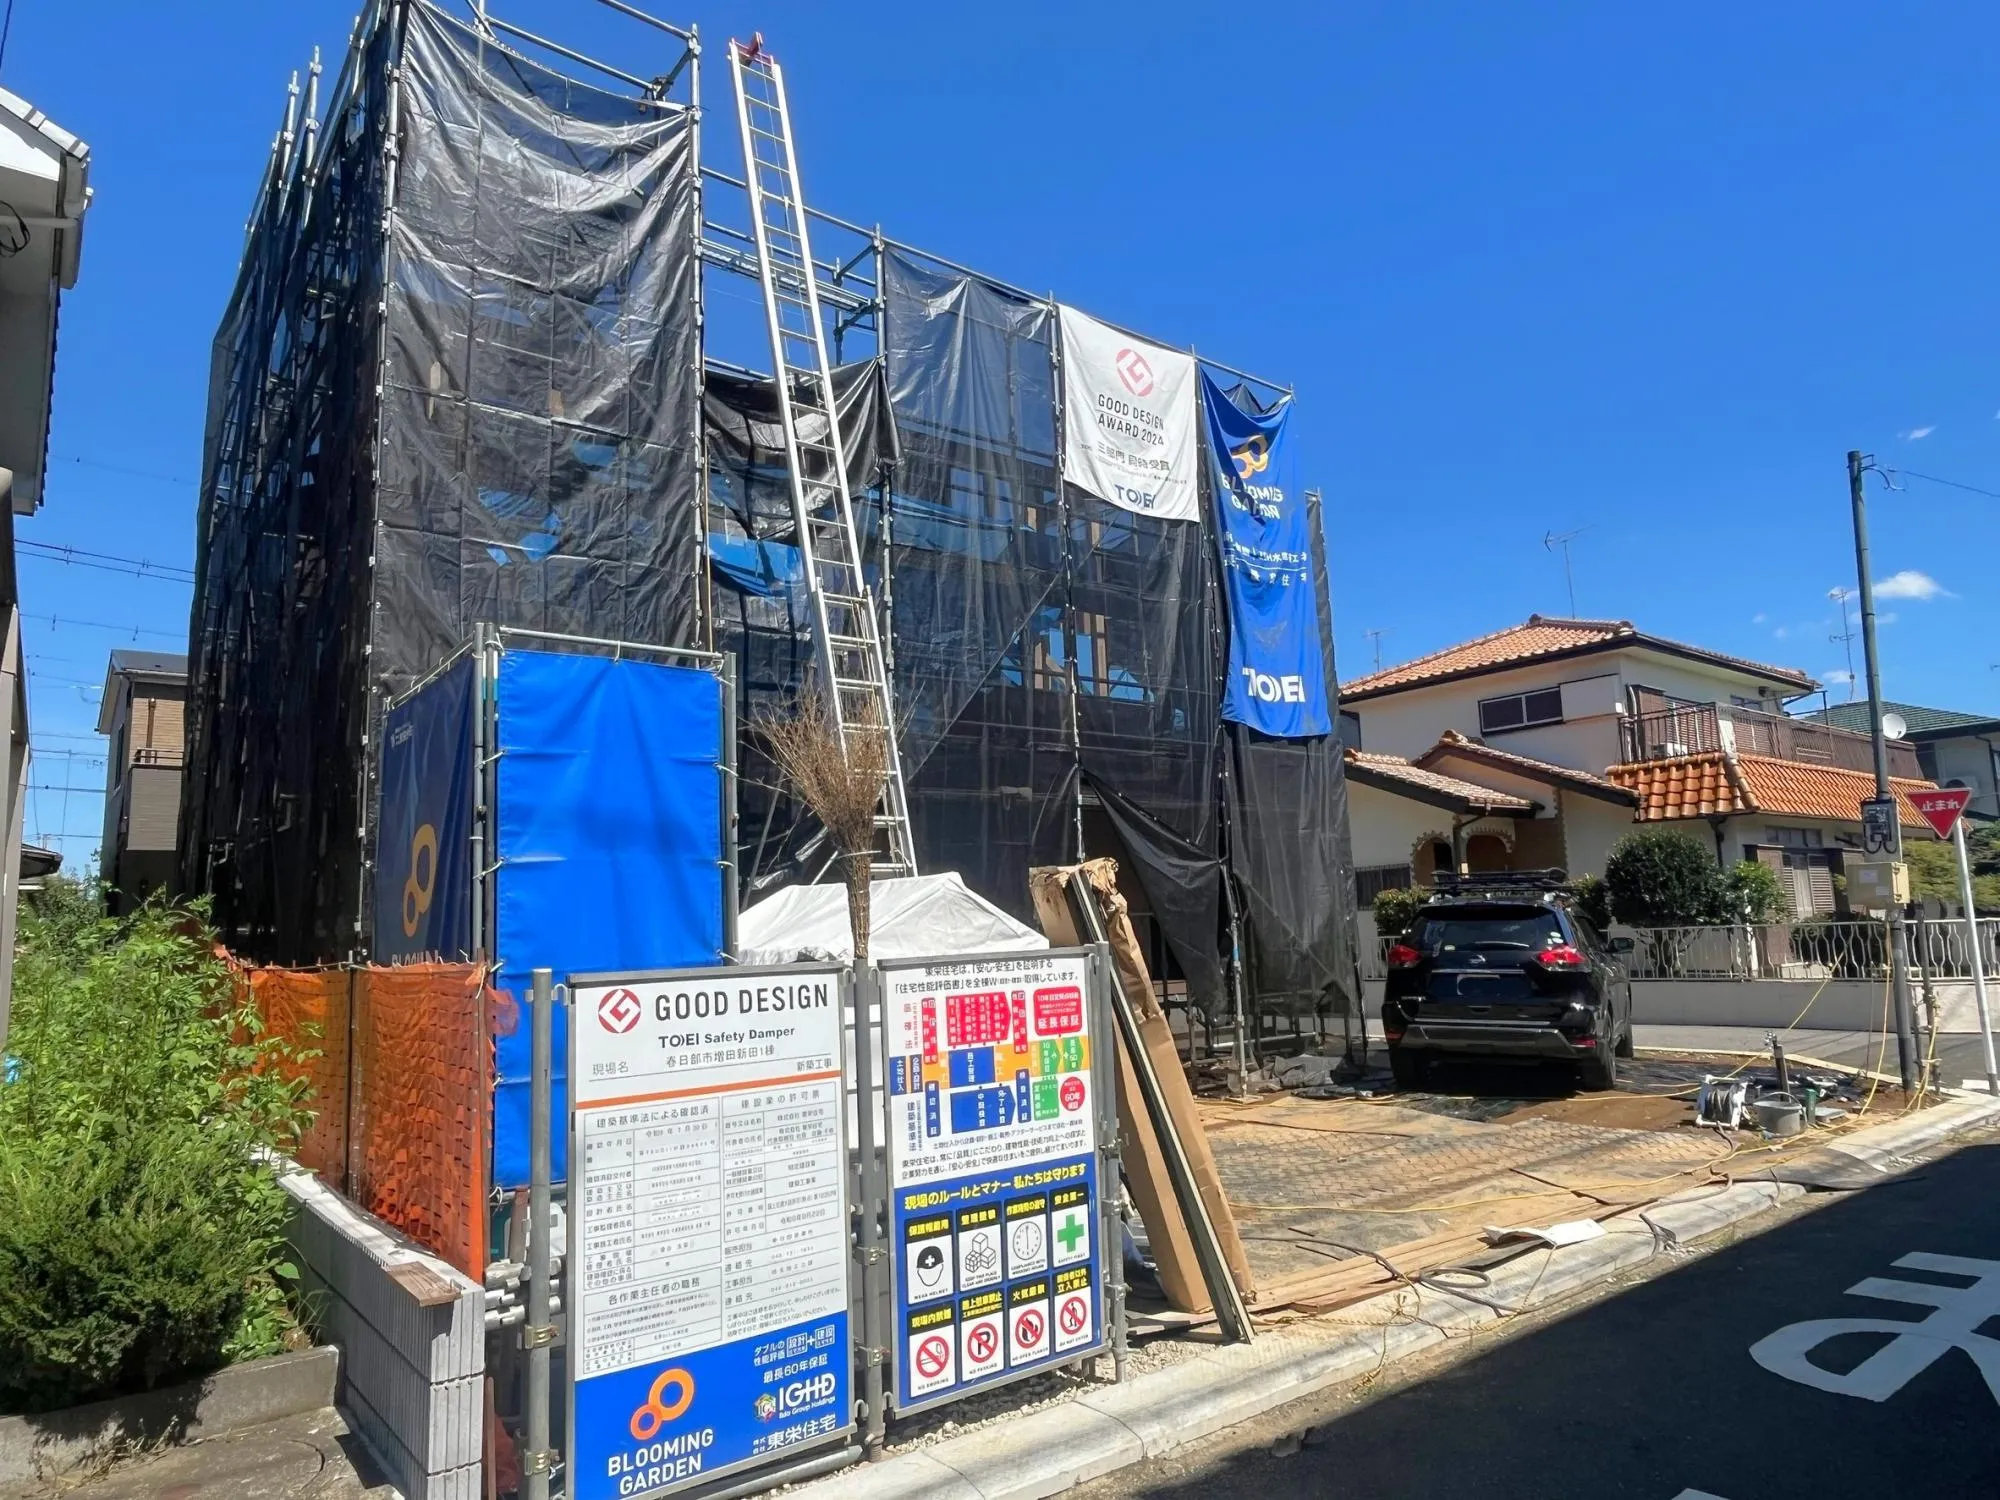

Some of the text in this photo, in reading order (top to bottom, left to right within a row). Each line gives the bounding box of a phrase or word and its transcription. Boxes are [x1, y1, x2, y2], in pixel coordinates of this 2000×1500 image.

[1098, 394, 1164, 431] GOOD DESIGN
[1098, 413, 1165, 446] AWARD 2024
[1922, 799, 1960, 812] 止まれ
[655, 983, 828, 1021] GOOD DESIGN
[704, 1030, 744, 1045] Safety
[749, 1026, 795, 1042] Damper
[592, 1061, 629, 1076] 現場名
[904, 1163, 1086, 1210] 現場のルールとマナー 私たちは守ります
[608, 1276, 700, 1306] 各作業主任者の職務
[754, 1340, 785, 1357] ダブルの
[764, 1352, 828, 1384] 最長60年保証
[767, 1413, 836, 1451] 東栄住宅
[608, 1428, 714, 1477] BLOOMING
[619, 1453, 702, 1496] GARDEN
